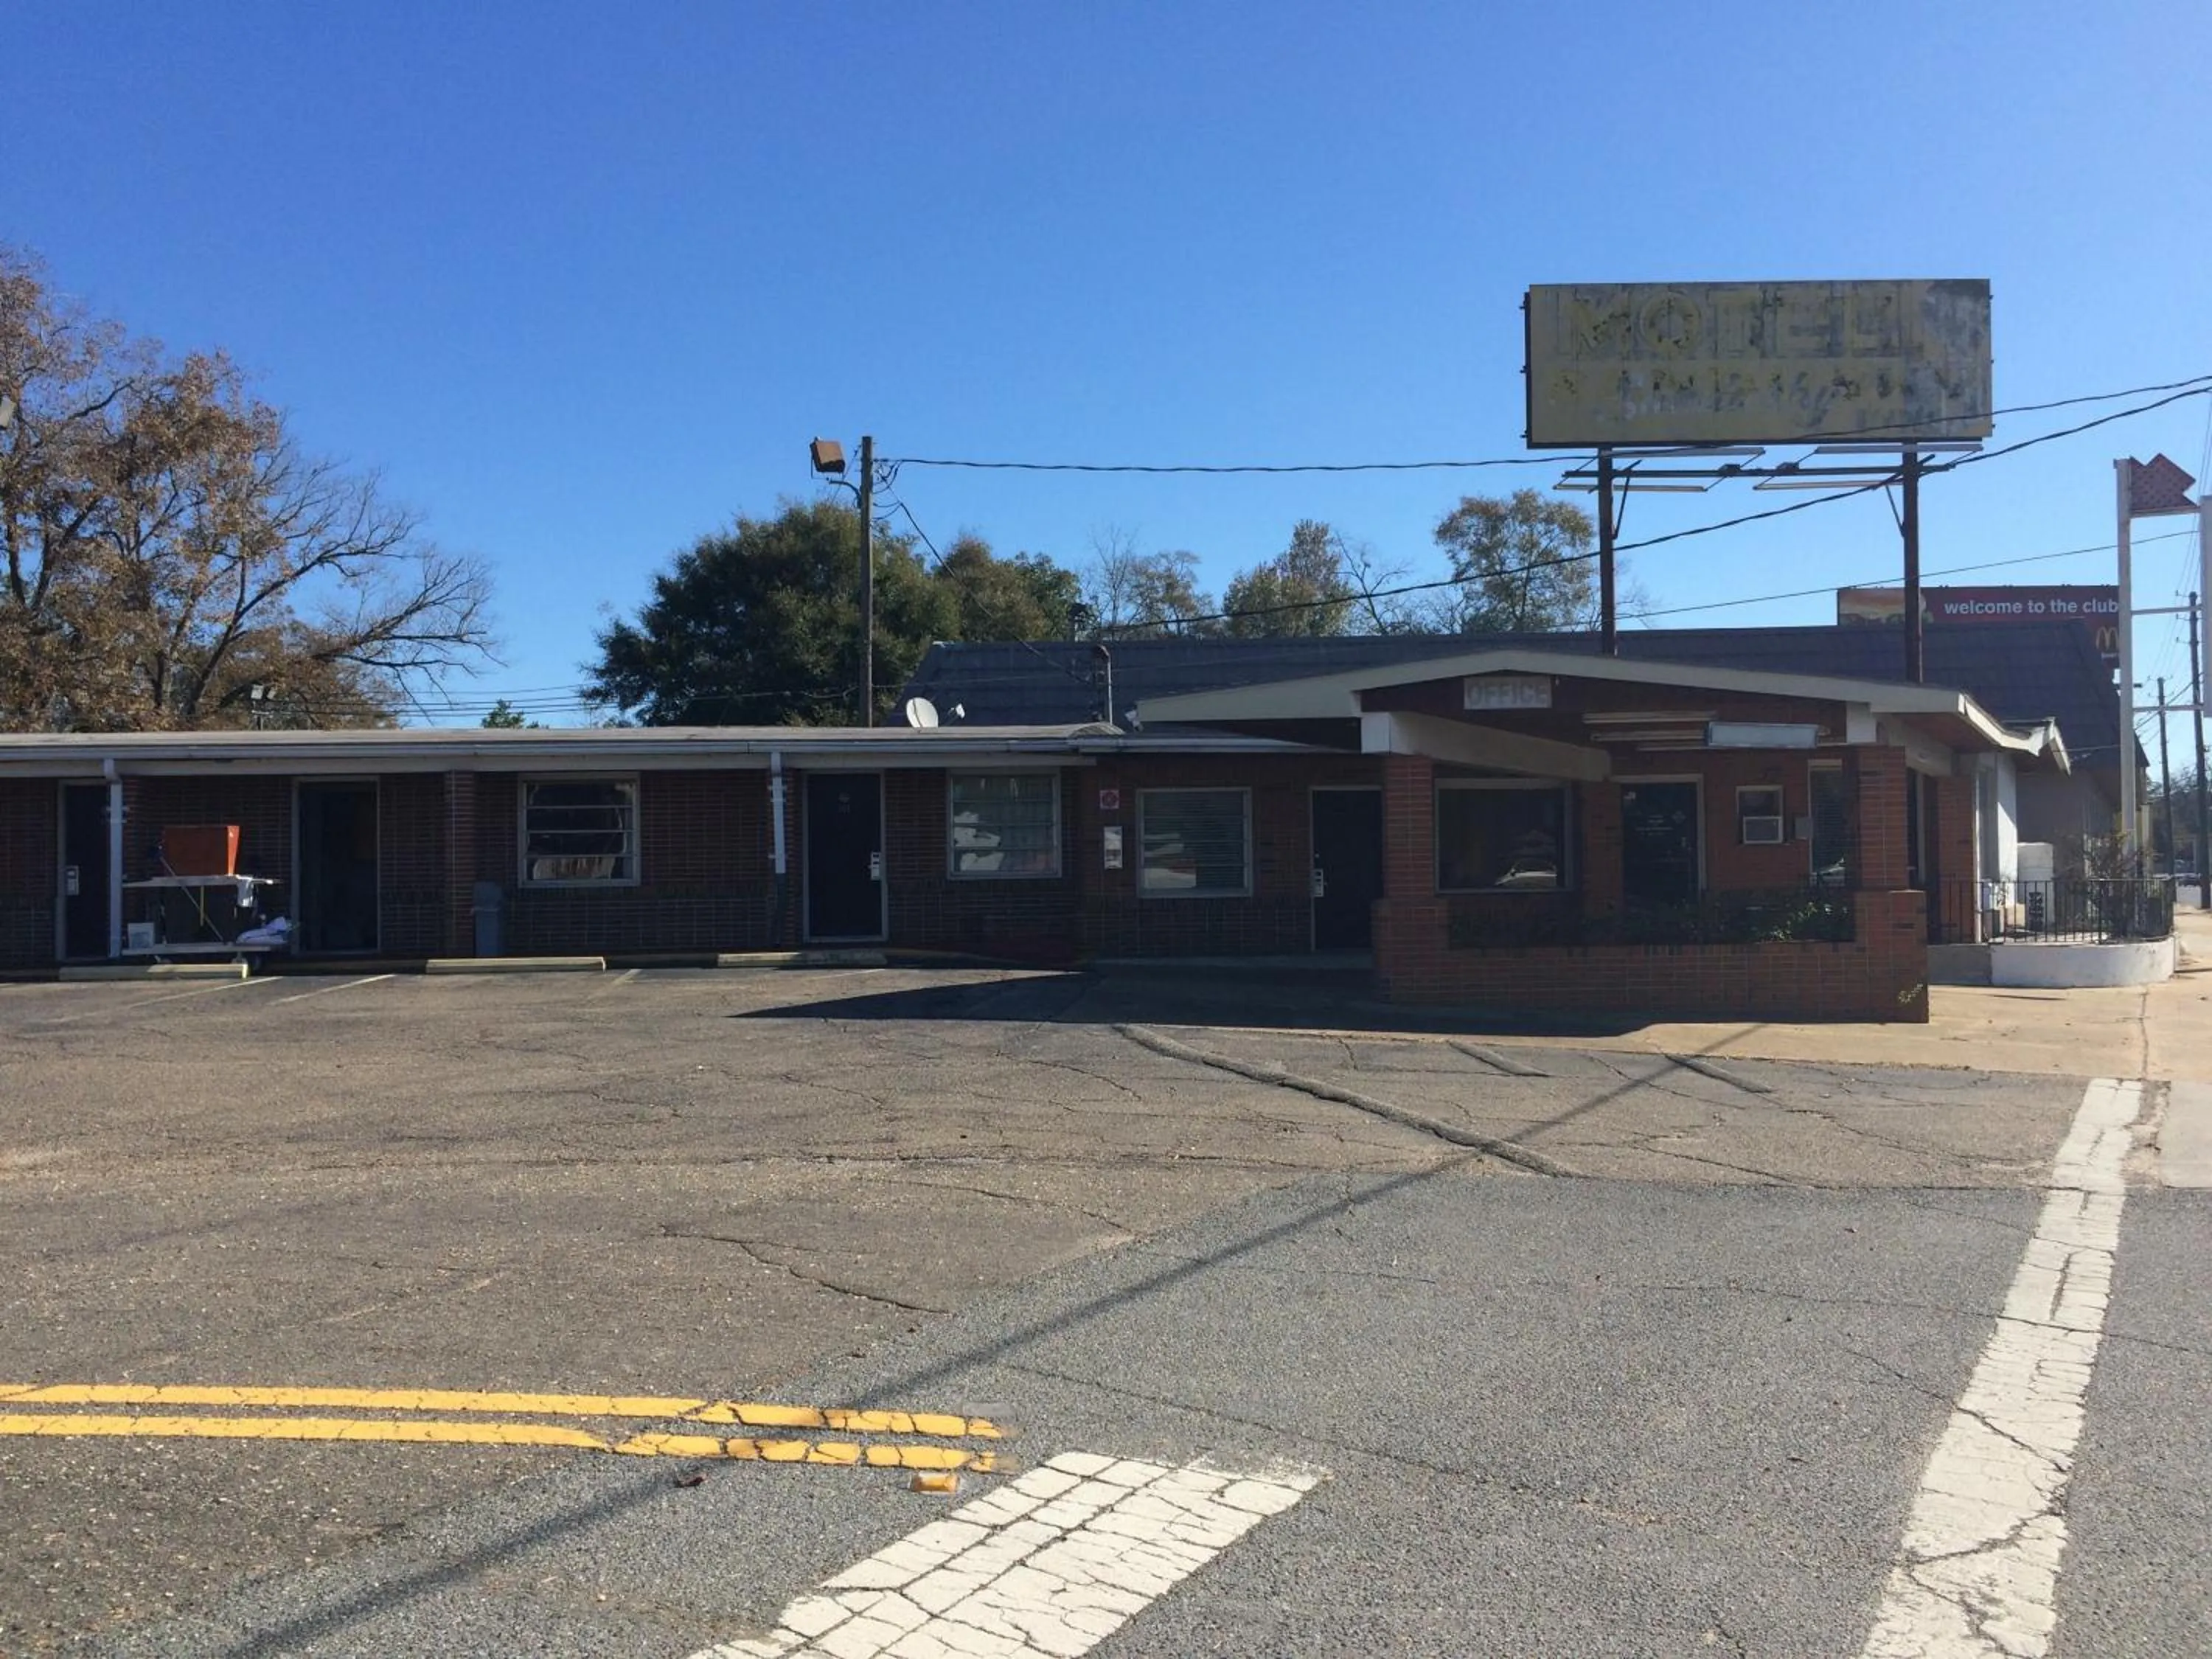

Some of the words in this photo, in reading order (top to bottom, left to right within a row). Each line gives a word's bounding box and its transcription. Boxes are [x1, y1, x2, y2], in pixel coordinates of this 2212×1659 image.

[1556, 285, 1924, 361] MOTEL
[1944, 599, 2023, 614] welcome
[2027, 599, 2045, 613] to
[2050, 598, 2078, 613] the
[2083, 597, 2118, 613] club
[1467, 683, 1548, 706] OFFICE
